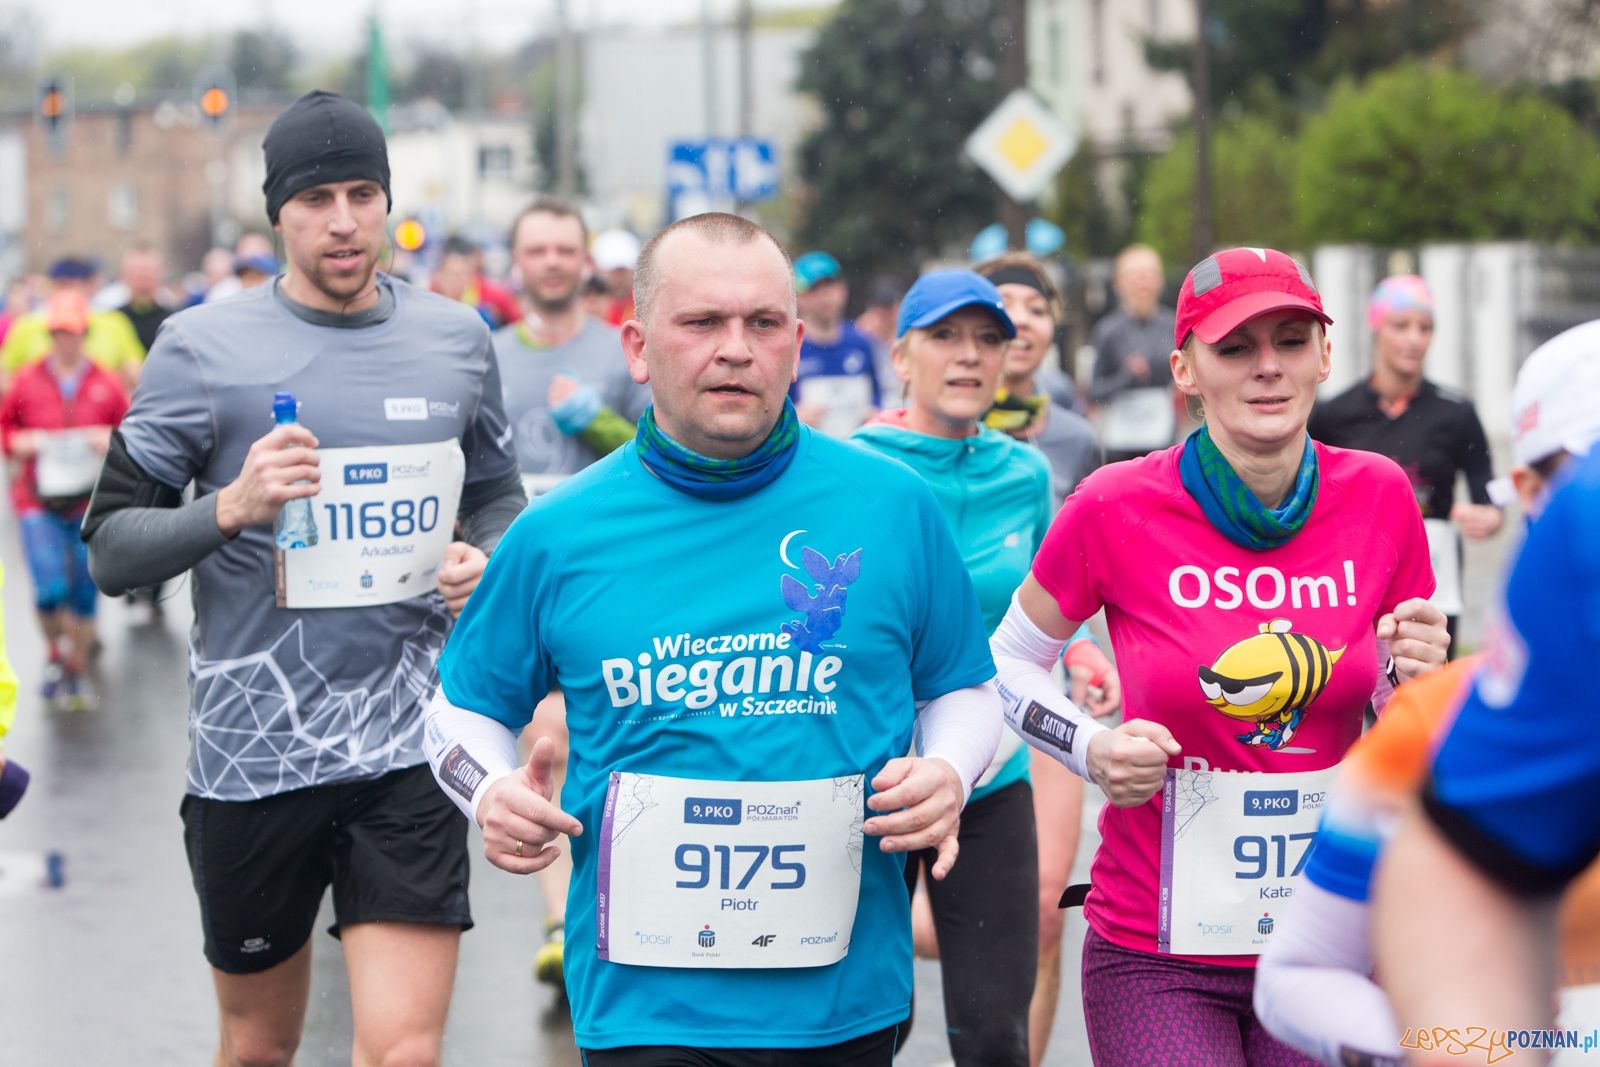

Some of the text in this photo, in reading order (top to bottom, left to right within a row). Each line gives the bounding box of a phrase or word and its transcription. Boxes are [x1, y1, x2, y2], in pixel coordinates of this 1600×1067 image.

[359, 467, 383, 480] PKO
[324, 495, 439, 541] 11680
[360, 544, 414, 558] Arkadiusz
[1169, 560, 1357, 610] OSOm!
[653, 632, 791, 660] Wieczorne
[719, 695, 837, 717] w Szczecinie
[1041, 714, 1074, 743] SATURN
[453, 759, 484, 791] SATURN
[1251, 798, 1290, 810] 9. PKO
[1302, 791, 1327, 804] POZ
[692, 805, 734, 818] 9. PKO
[1233, 832, 1319, 880] 917
[674, 843, 806, 890] 9175
[1260, 886, 1297, 900] Kata
[721, 898, 759, 911] Piotr
[751, 934, 777, 948] 4F
